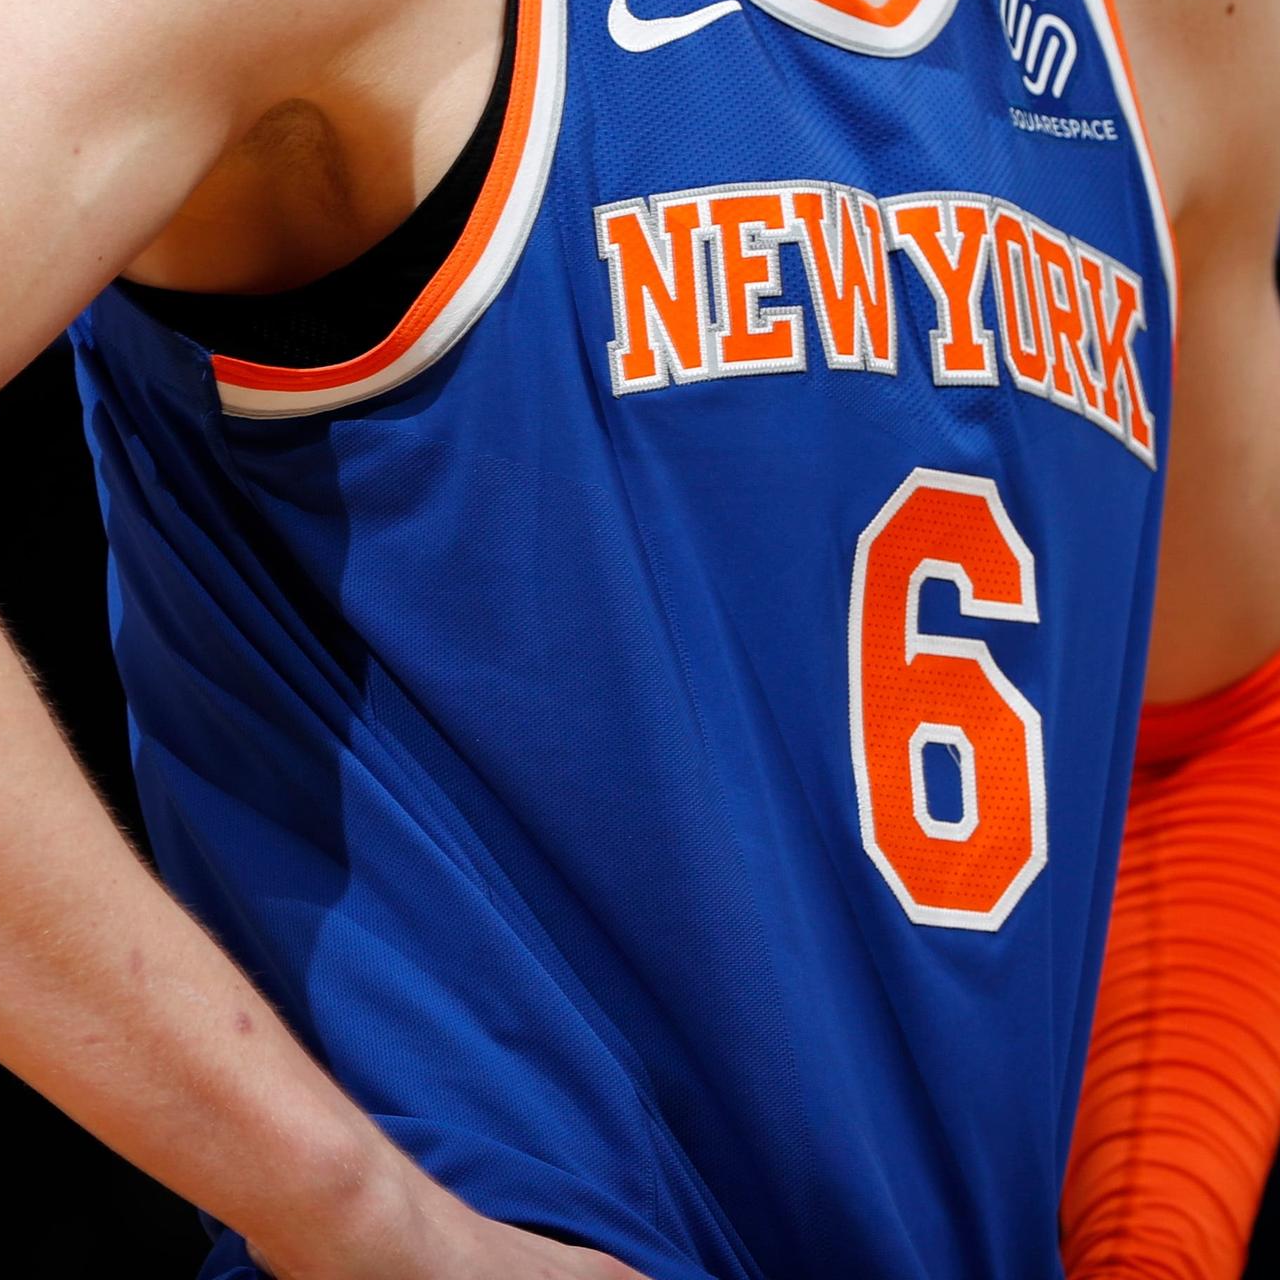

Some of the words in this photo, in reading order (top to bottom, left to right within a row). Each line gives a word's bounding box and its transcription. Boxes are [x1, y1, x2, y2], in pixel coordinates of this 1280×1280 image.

[1009, 106, 1118, 140] SQUARESPACE
[593, 180, 897, 398] NEW
[877, 191, 1156, 471] YORK
[848, 467, 1048, 932] 6
